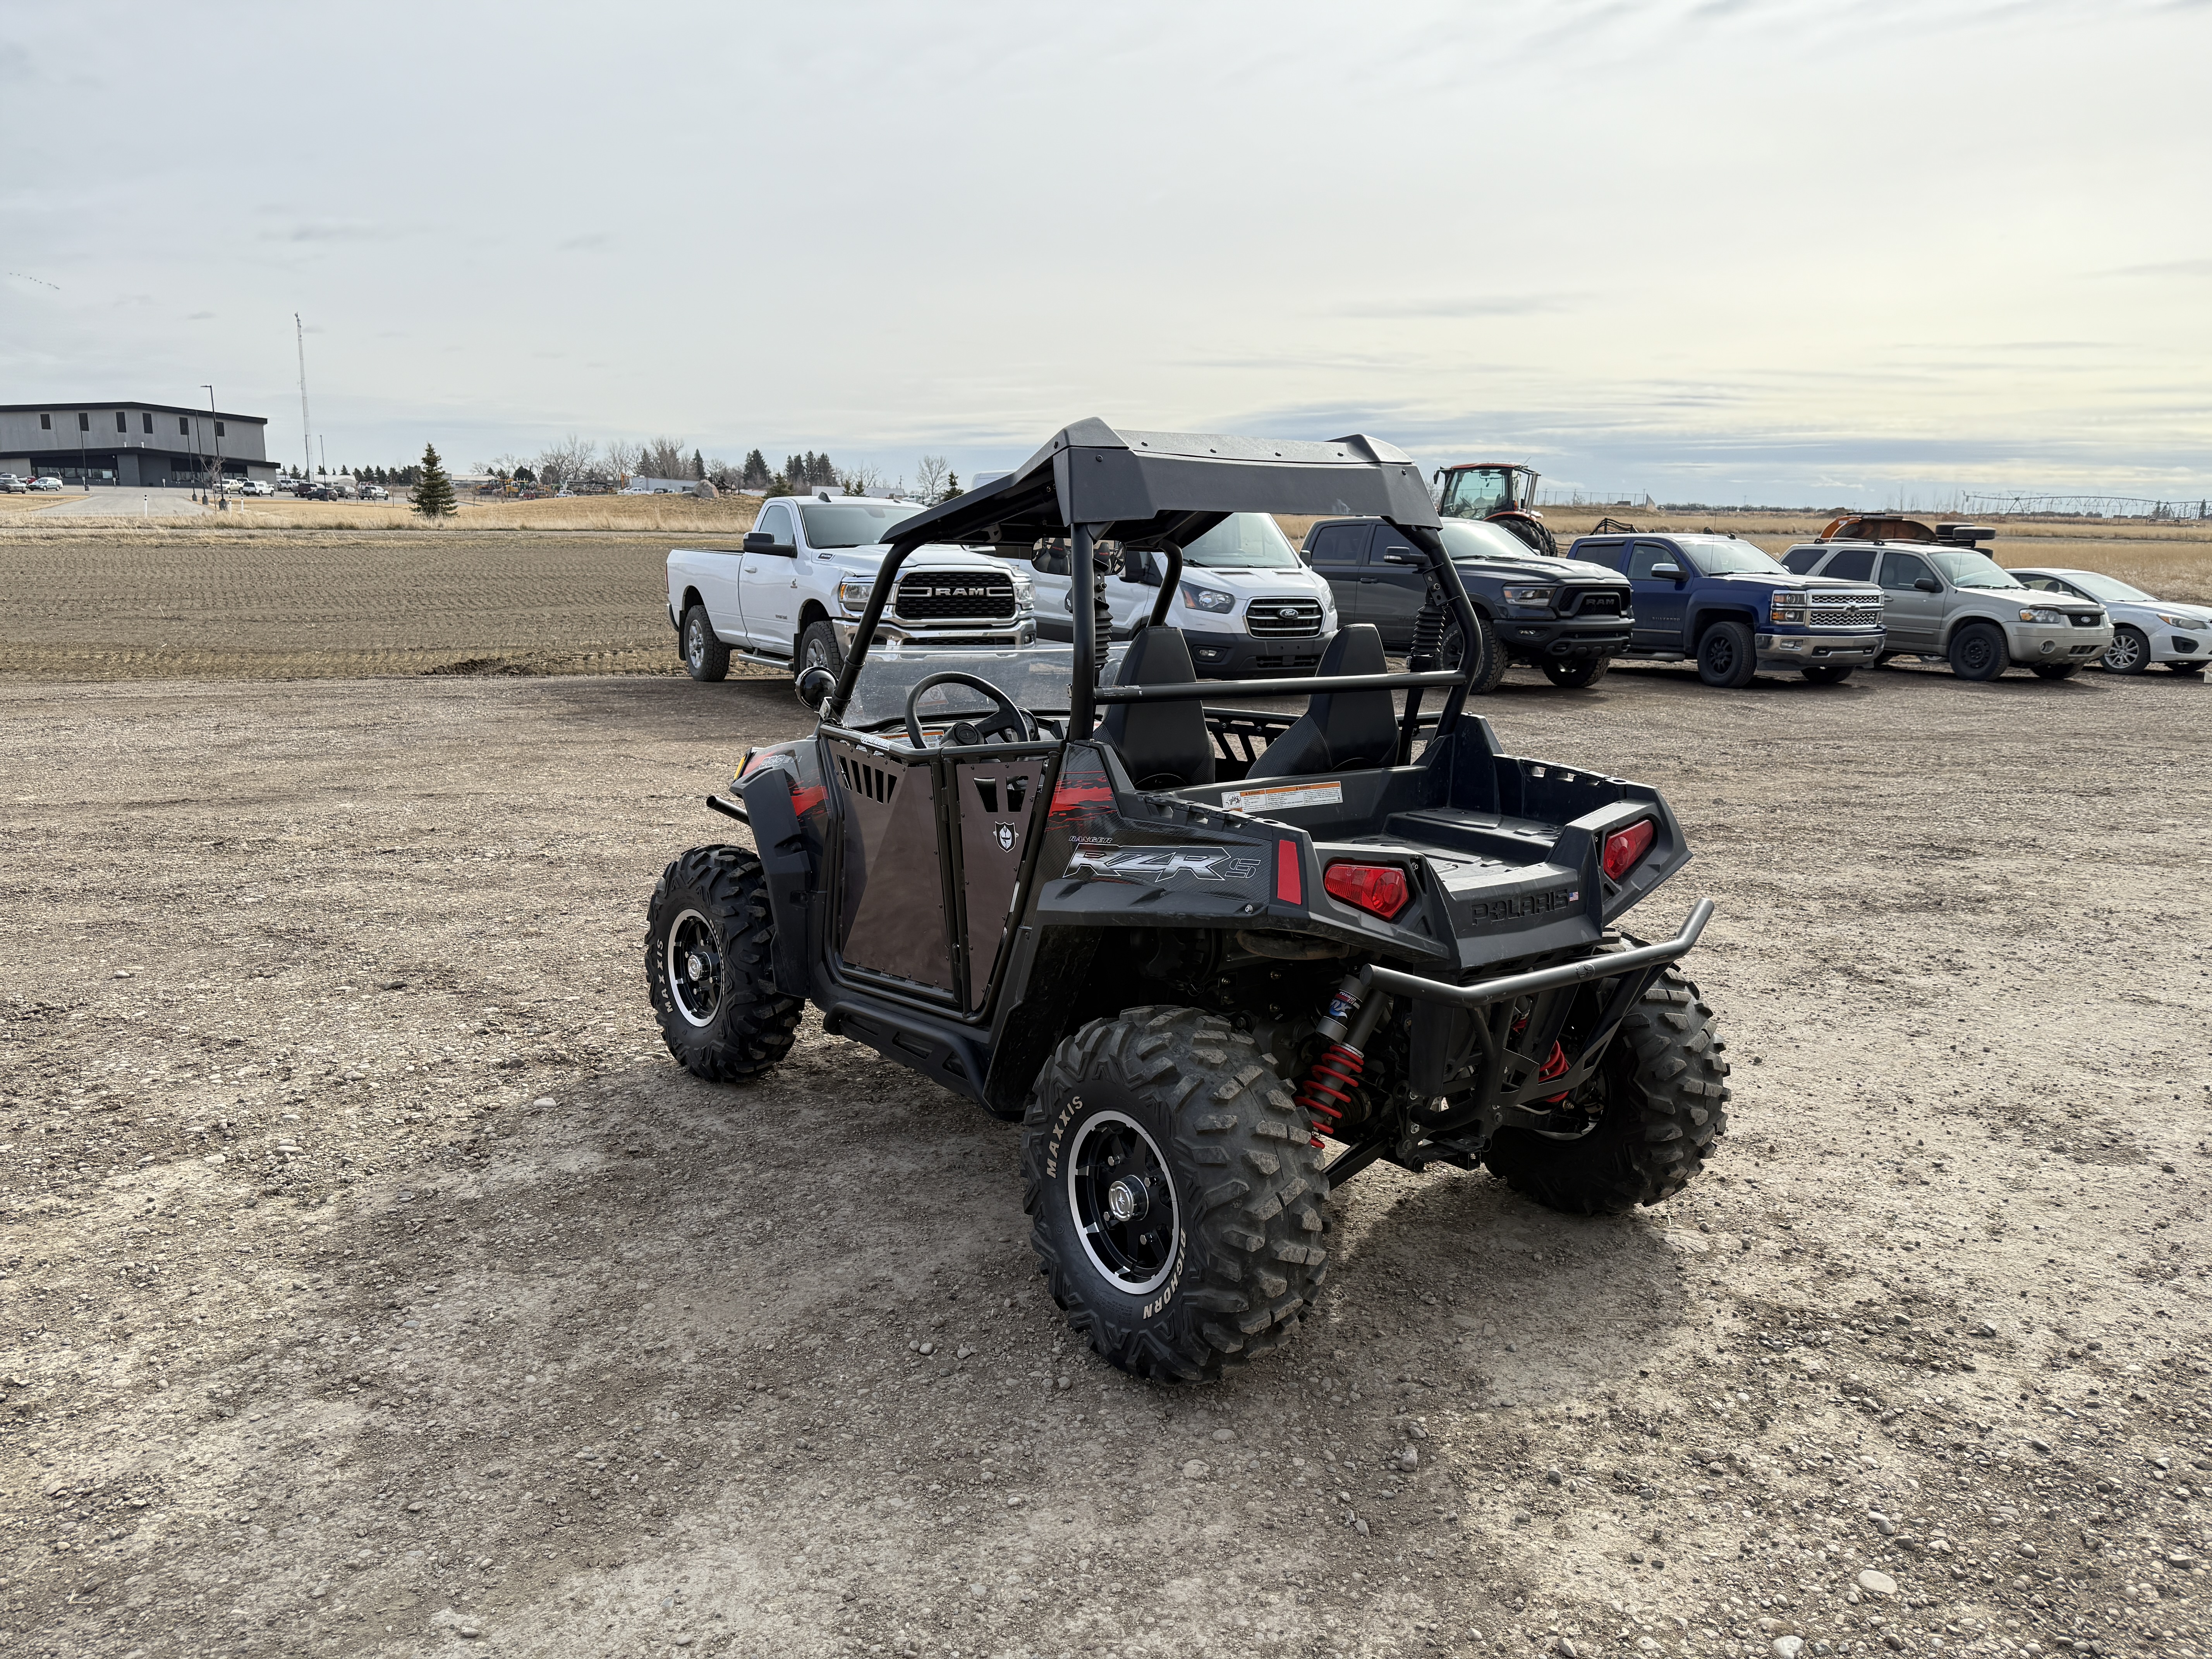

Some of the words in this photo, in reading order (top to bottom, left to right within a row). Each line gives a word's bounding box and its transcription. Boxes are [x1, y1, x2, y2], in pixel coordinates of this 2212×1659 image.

[1062, 843, 1231, 883] RZR
[1471, 888, 1568, 926] POLARIS
[657, 938, 673, 1013] MAXXIS
[1046, 1096, 1083, 1178] MAXXIS
[1143, 1227, 1186, 1319] BIGHORN
